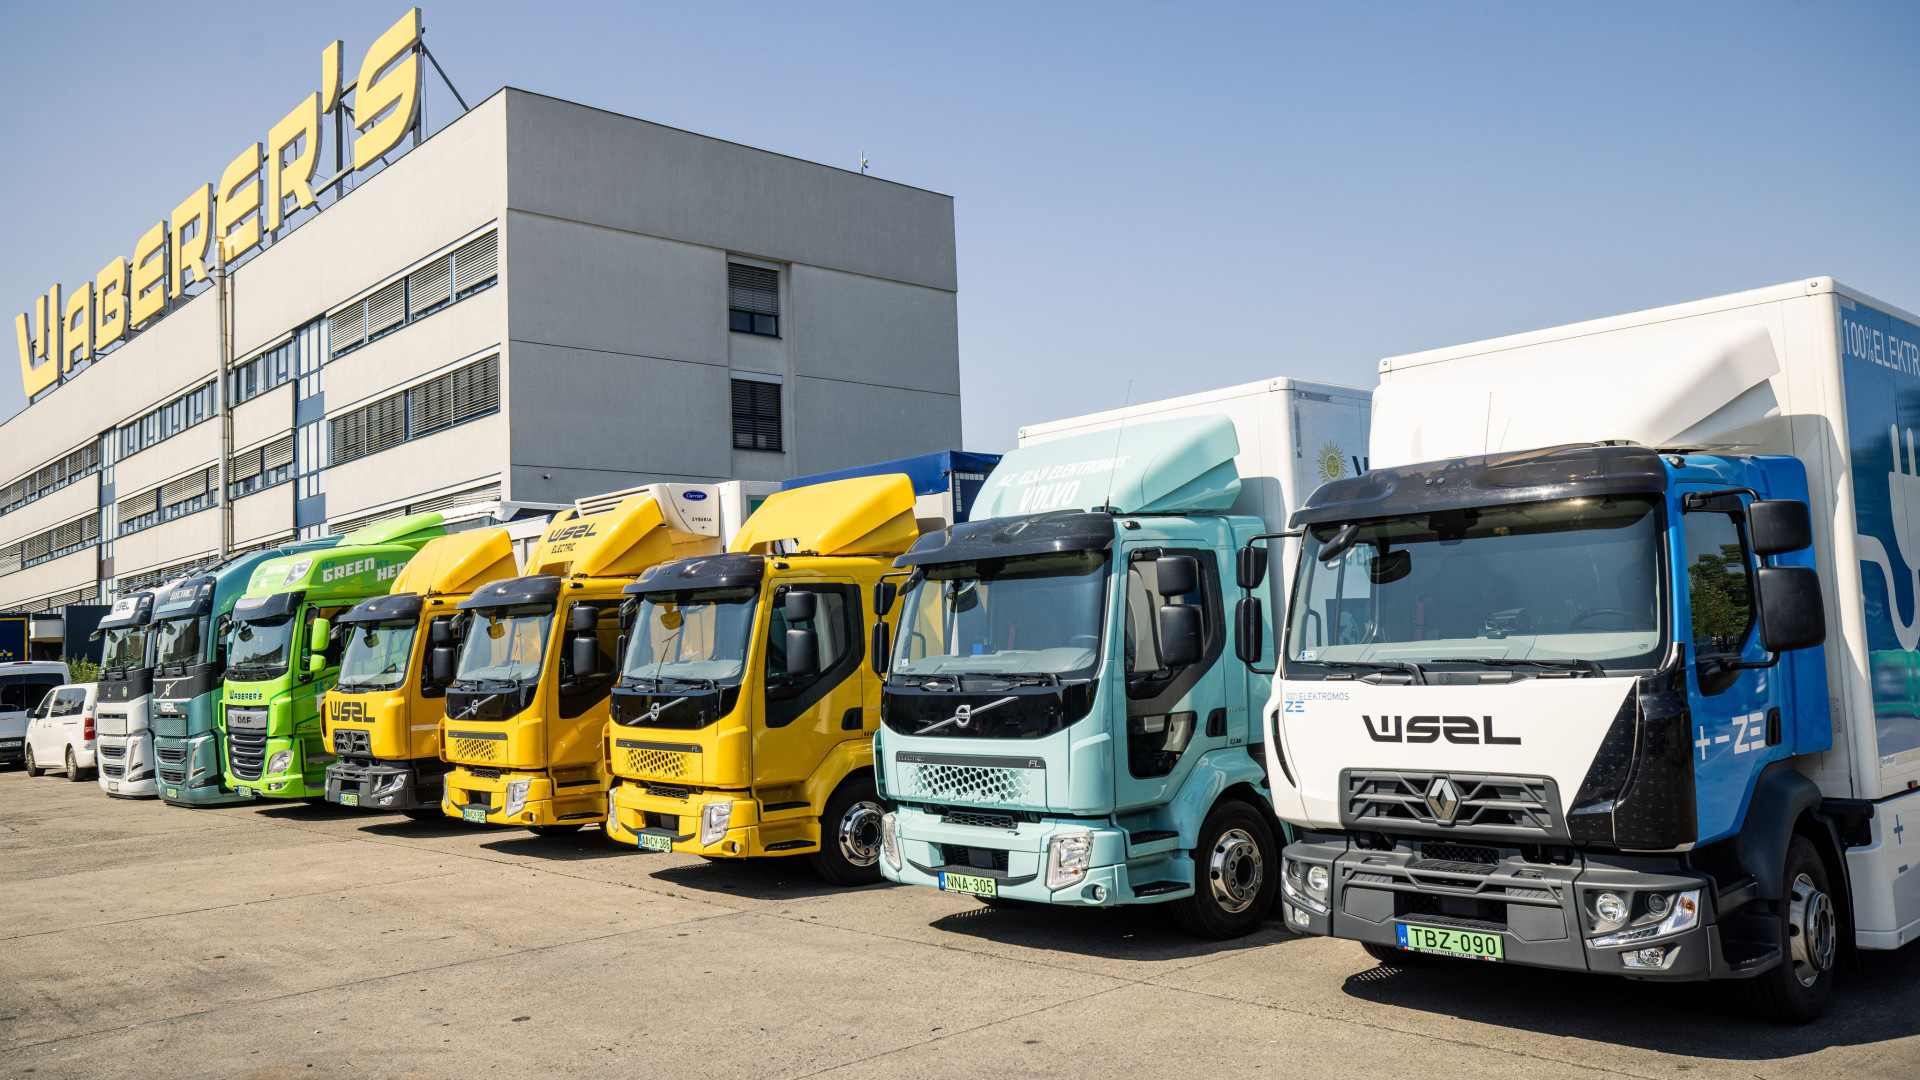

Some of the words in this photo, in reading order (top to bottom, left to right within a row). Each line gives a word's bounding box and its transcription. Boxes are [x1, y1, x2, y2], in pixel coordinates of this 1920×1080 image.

[15, 7, 422, 398] WABERER'S
[1843, 318, 1920, 377] 100%ELEKTR
[1018, 479, 1081, 513] VOLVO
[322, 557, 375, 583] GREEN
[237, 716, 252, 724] DAF
[946, 874, 993, 894] NNA-305
[1410, 927, 1497, 956] TBZ-090
